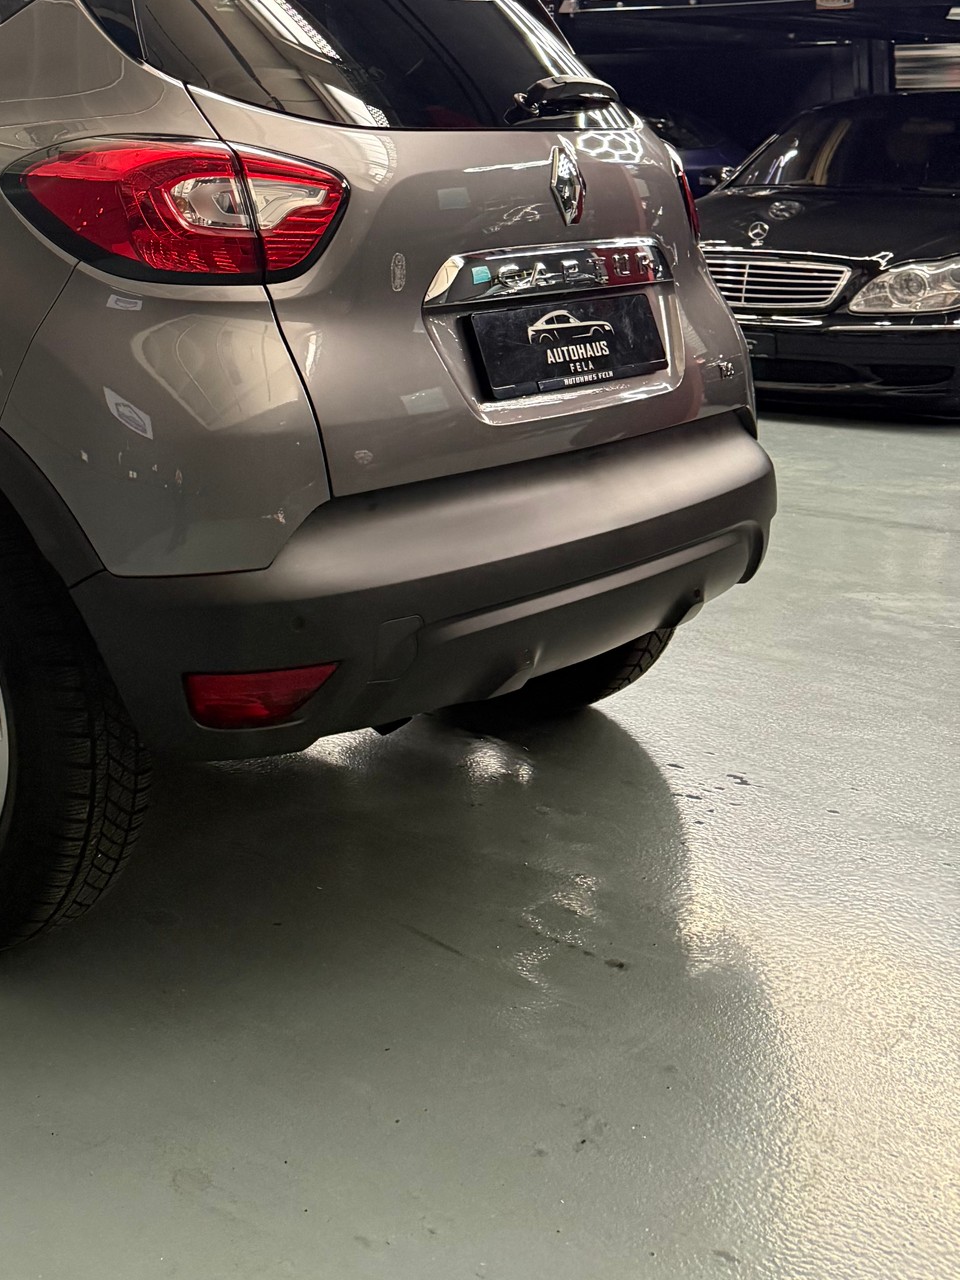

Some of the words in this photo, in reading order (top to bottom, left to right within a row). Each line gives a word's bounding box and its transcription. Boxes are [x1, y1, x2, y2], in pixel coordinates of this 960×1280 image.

[497, 252, 654, 288] CAPTUR
[546, 340, 610, 365] AUTOHAUS
[570, 360, 595, 373] FELA
[564, 373, 597, 386] AUTOHAUS
[598, 370, 614, 380] FELA
